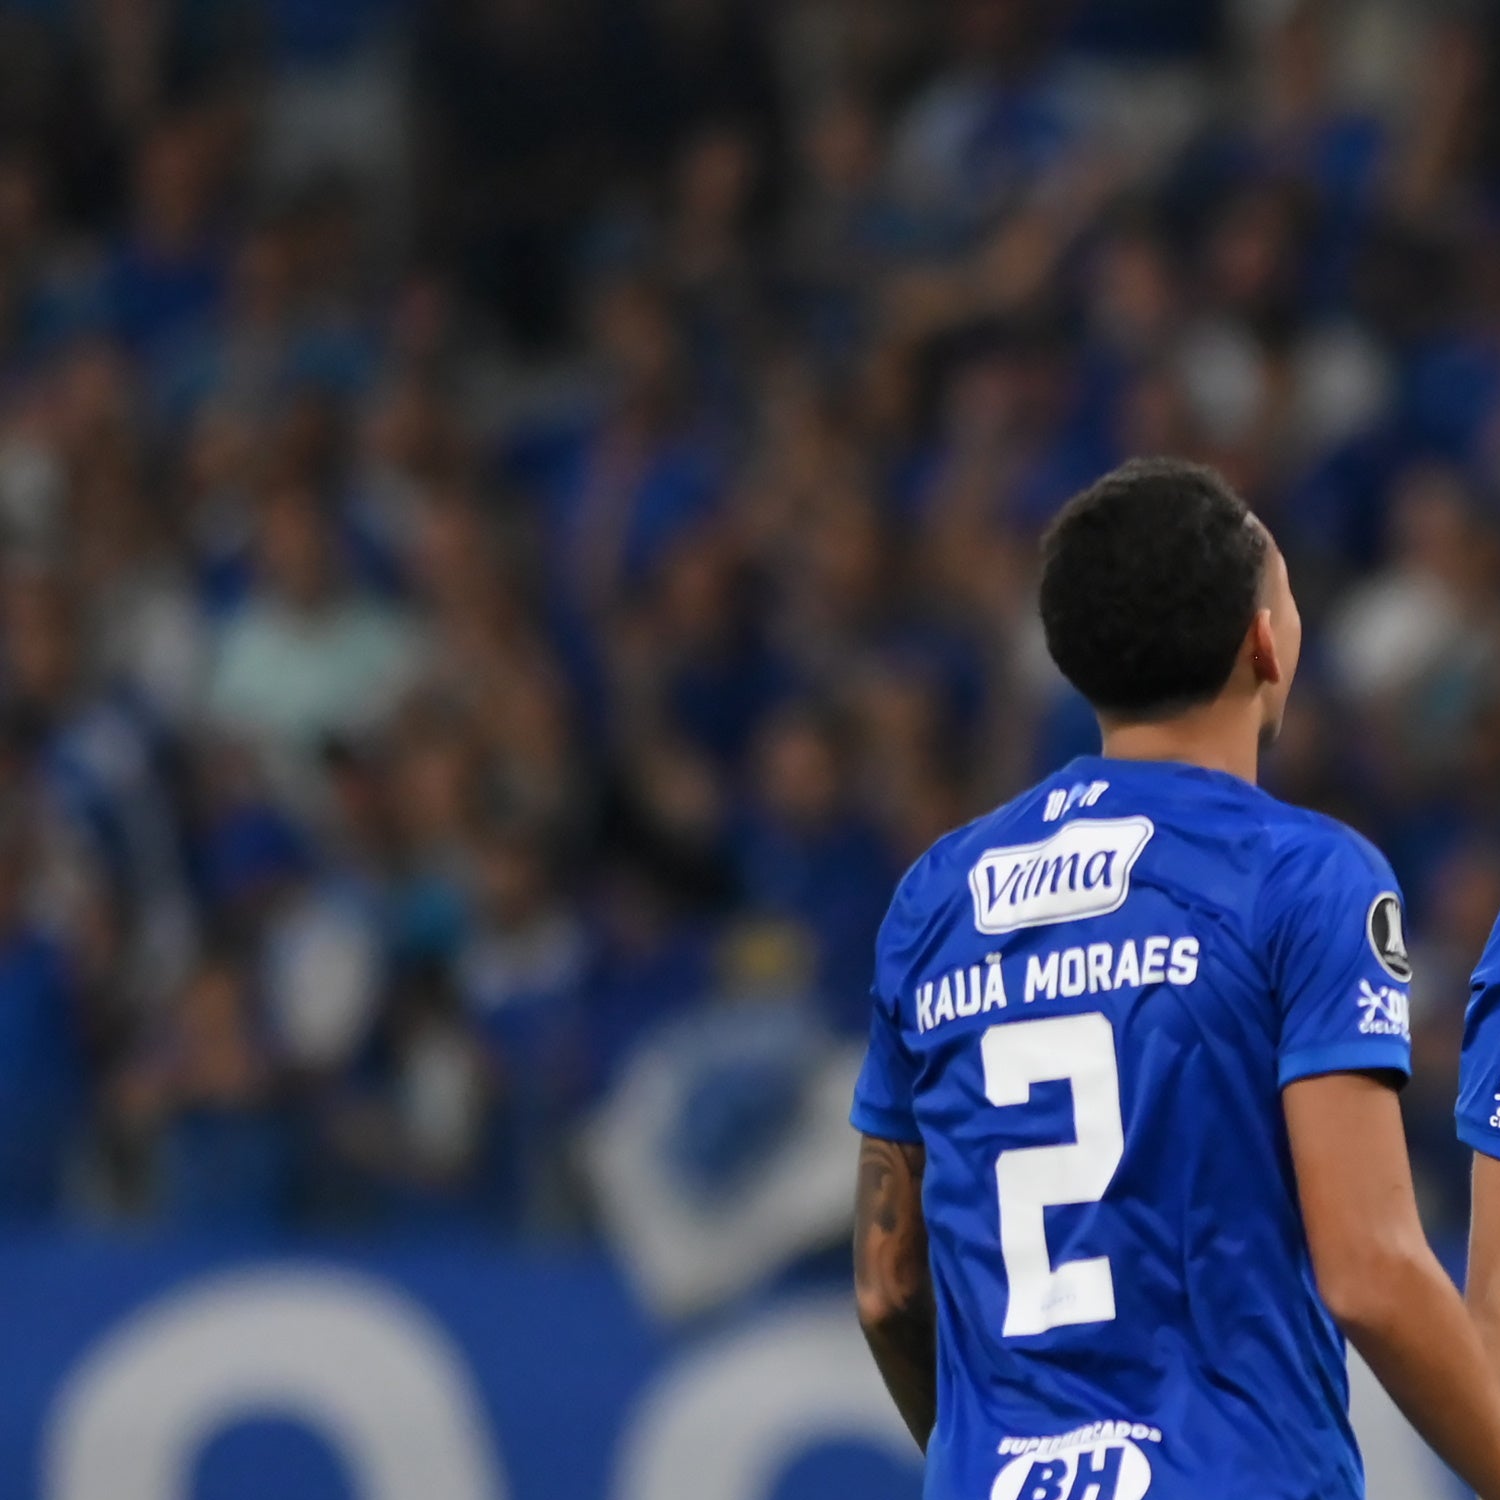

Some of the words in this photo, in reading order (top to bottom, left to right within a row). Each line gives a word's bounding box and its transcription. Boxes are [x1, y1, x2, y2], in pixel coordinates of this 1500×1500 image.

[985, 849, 1118, 913] Vilma
[1023, 935, 1200, 1004] MORAES
[980, 1011, 1124, 1338] 2
